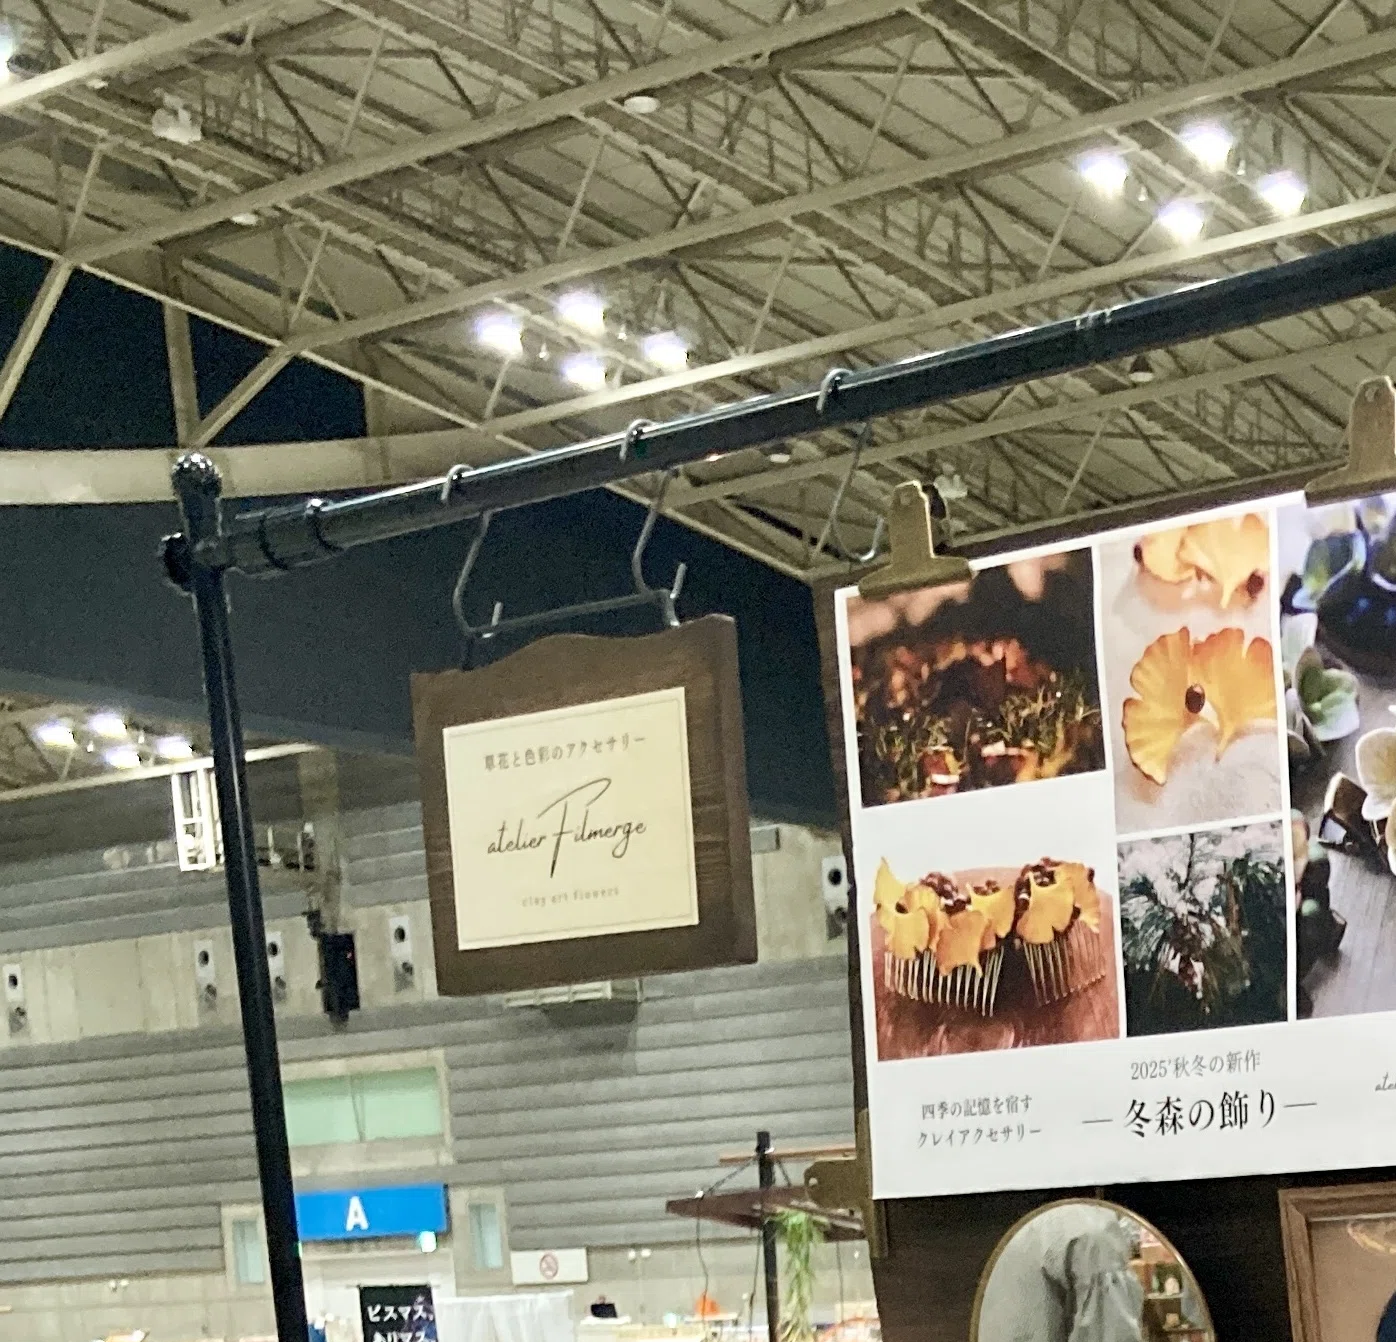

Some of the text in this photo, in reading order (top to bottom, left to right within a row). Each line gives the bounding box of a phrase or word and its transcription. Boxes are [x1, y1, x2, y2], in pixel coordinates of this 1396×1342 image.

[487, 819, 547, 854] atelier
[921, 1095, 1033, 1121] 四季の記憶を宿す
[917, 1125, 1042, 1149] クレイアクセサリー
[345, 1196, 369, 1231] A
